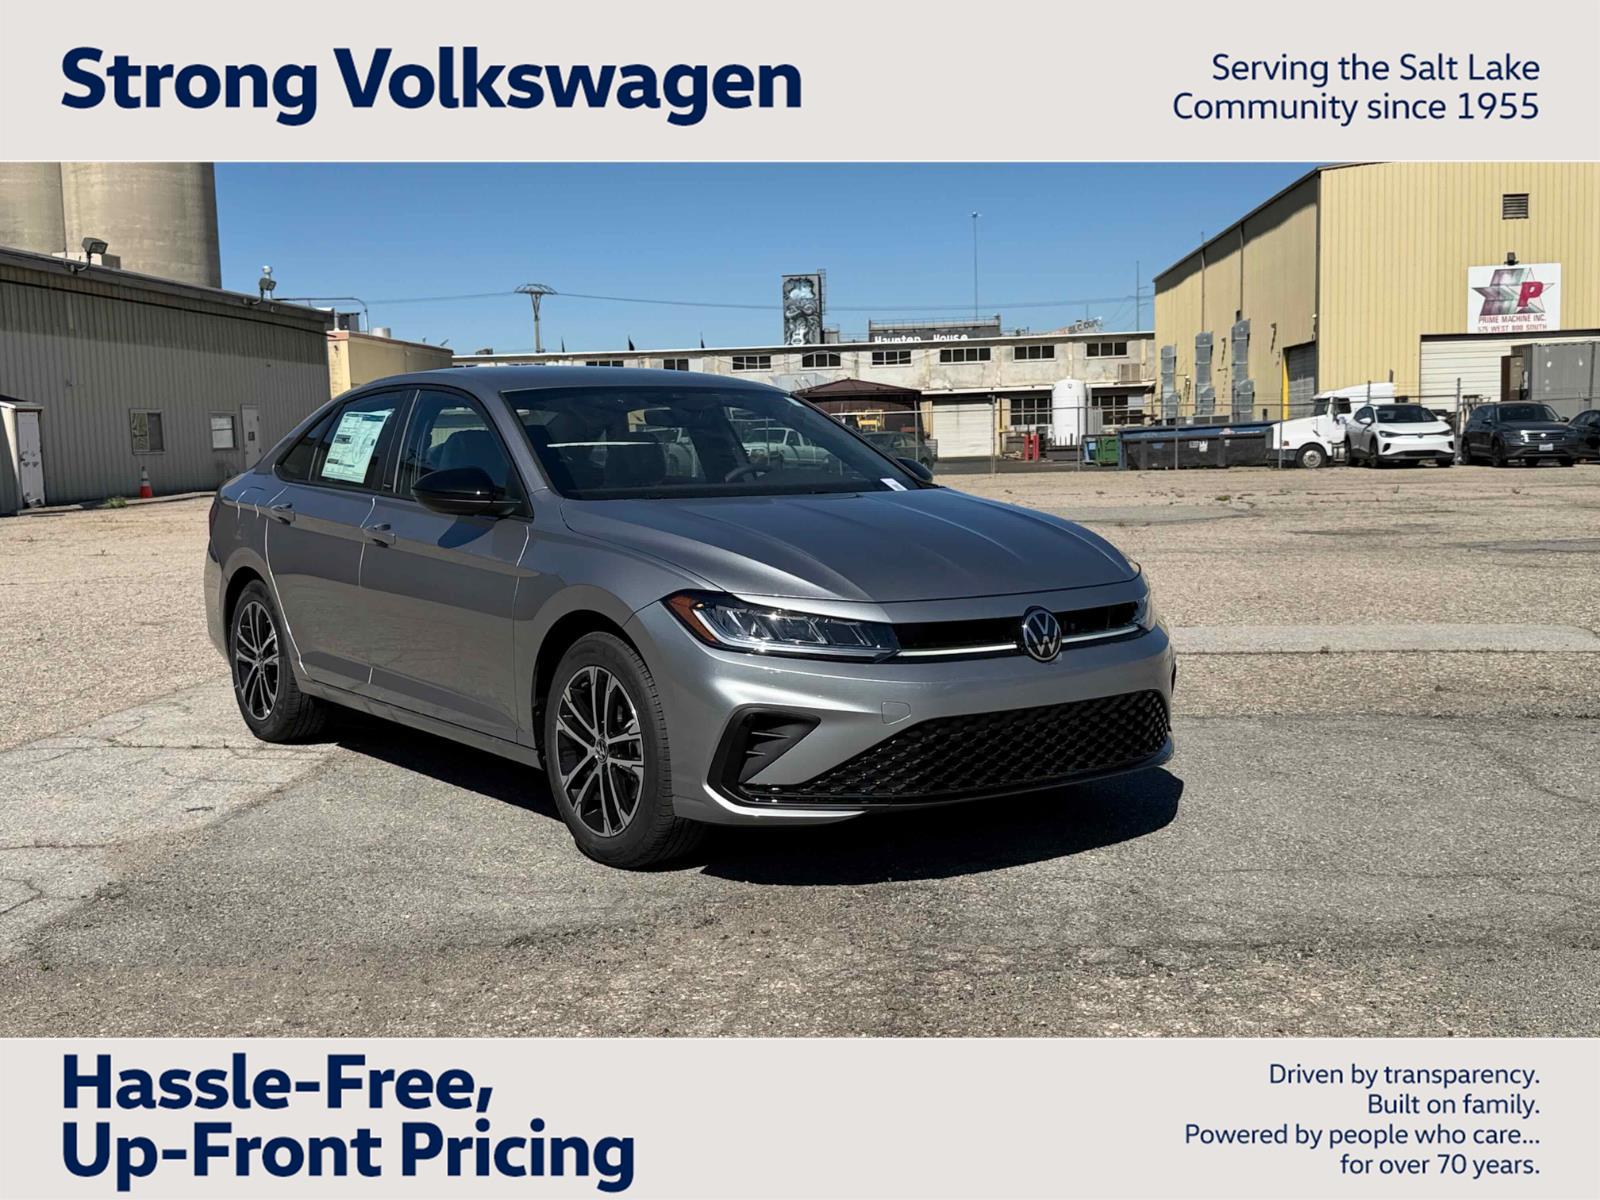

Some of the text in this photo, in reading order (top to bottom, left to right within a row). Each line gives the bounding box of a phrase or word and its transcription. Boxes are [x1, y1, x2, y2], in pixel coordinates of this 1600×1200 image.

[1517, 281, 1544, 307] P
[1479, 315, 1498, 324] PRIME
[1502, 314, 1531, 323] MACHINE
